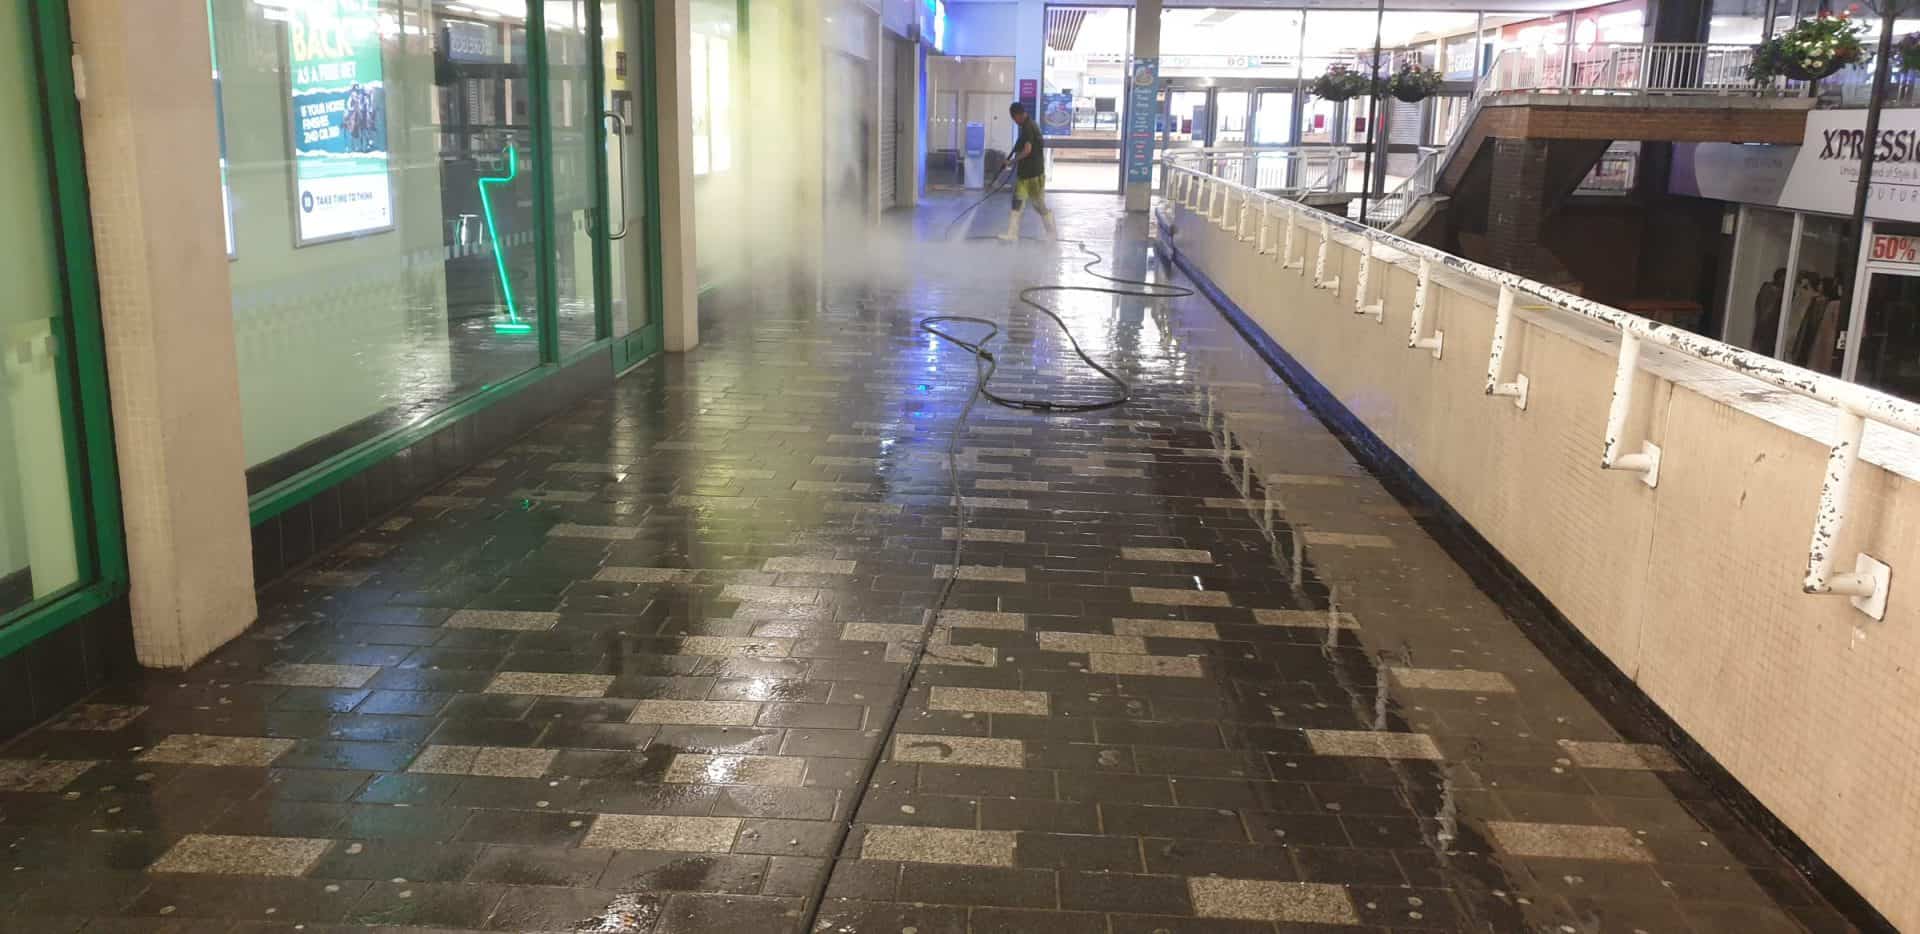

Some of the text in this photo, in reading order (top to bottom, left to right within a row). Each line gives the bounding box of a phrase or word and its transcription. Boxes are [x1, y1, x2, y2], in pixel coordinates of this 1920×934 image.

[292, 18, 354, 61] BACK
[315, 194, 332, 206] TAKE
[1872, 236, 1916, 260] 50%
